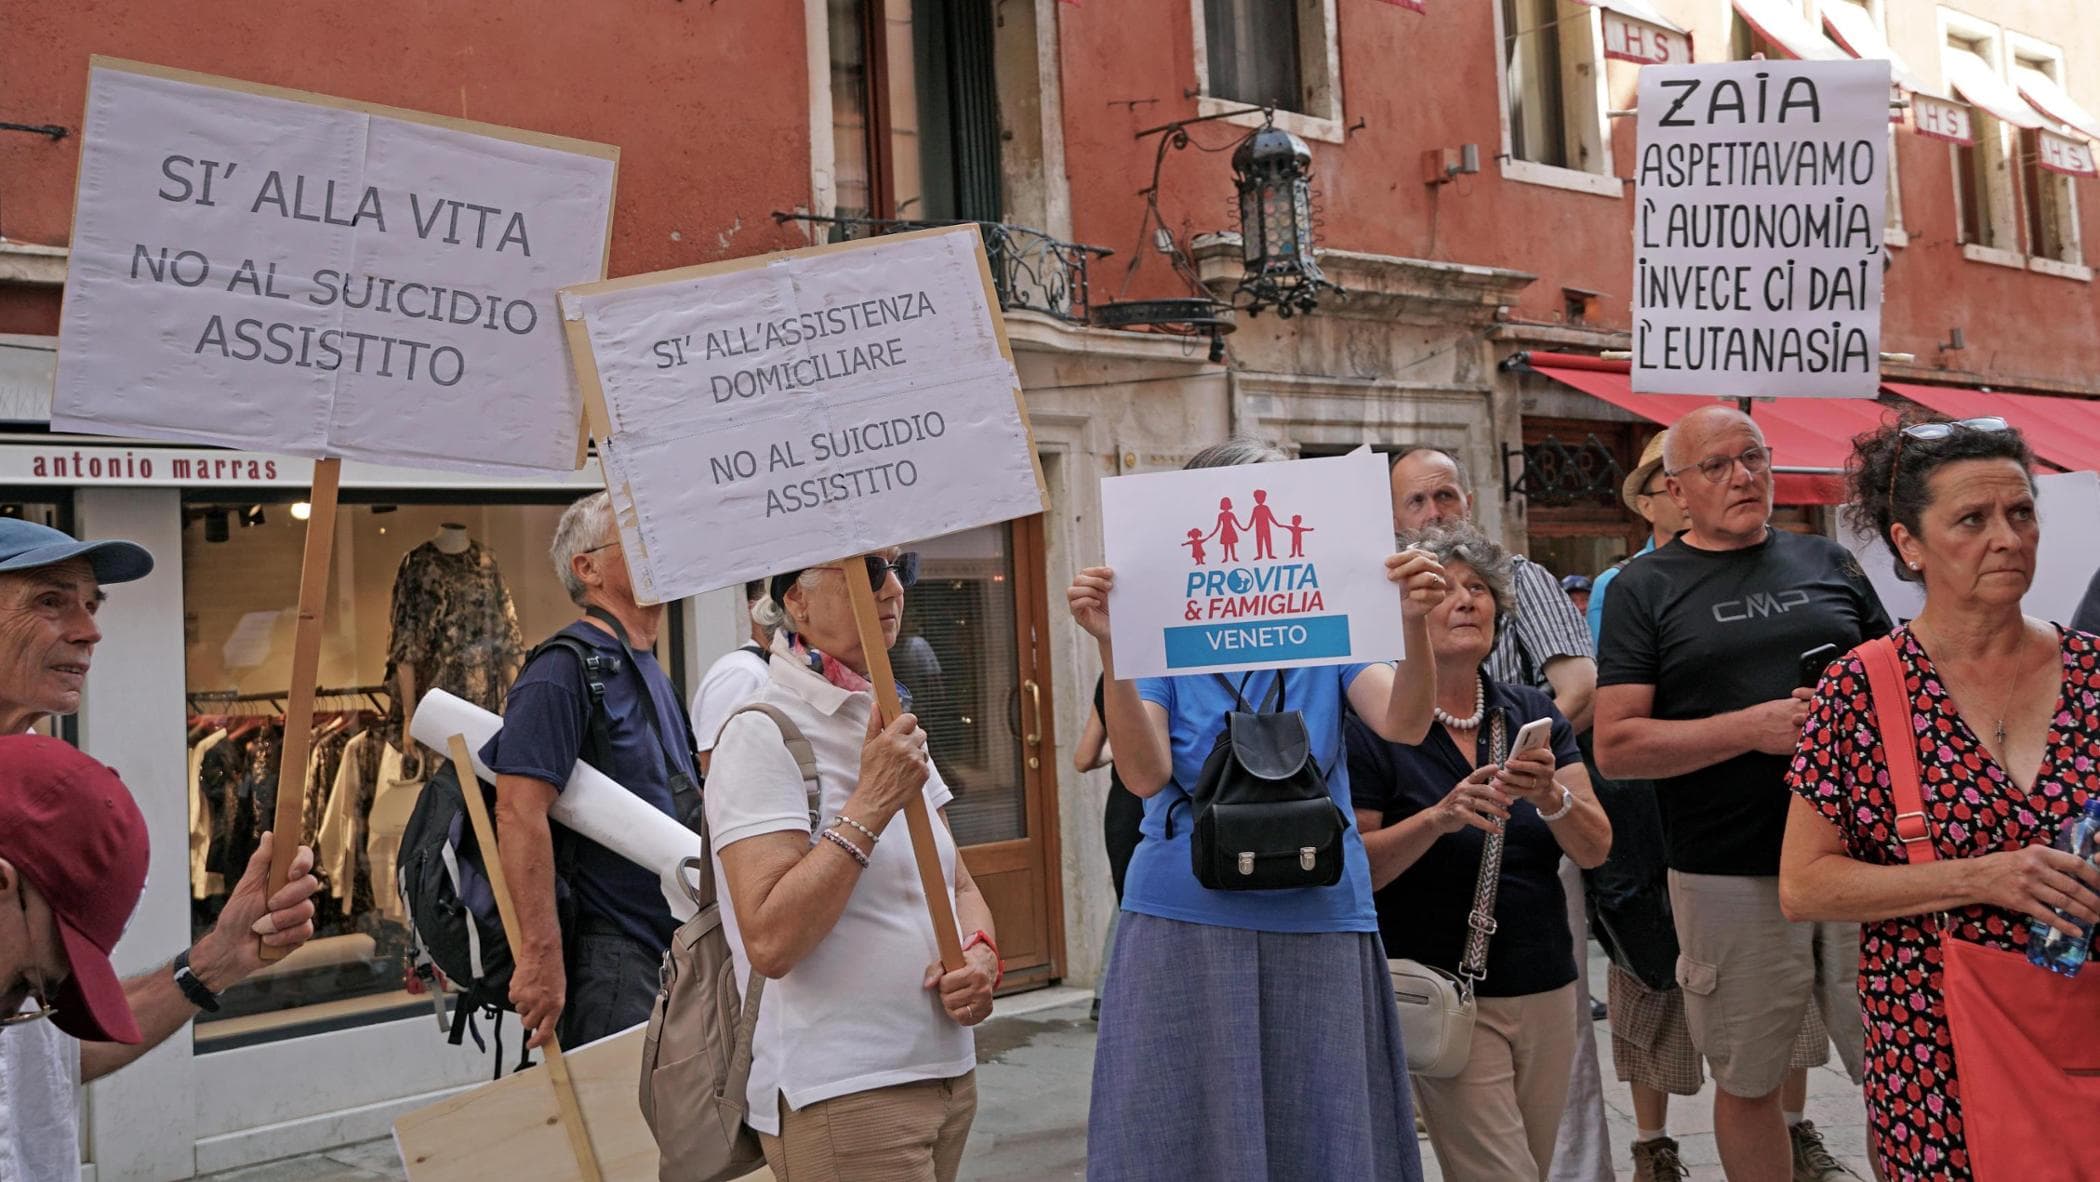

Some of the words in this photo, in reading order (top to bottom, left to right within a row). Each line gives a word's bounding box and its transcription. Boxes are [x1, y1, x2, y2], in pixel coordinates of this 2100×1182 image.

[1658, 72, 1821, 127] ZAIA
[1640, 140, 1874, 188] ASPETTAVAMO
[250, 170, 387, 233] ALLA
[409, 192, 532, 257] VITA
[130, 244, 209, 288] NO
[227, 259, 291, 300] AL
[309, 269, 538, 335] SUICIDIO
[1639, 258, 1752, 312] INVECE
[1764, 260, 1795, 313] CI
[1809, 259, 1869, 312] DAI
[195, 314, 466, 387] ASSISTITO
[711, 338, 907, 404] DOMICILIARE
[33, 451, 153, 478] antonio
[172, 458, 278, 480] marras
[710, 450, 757, 485] NO
[769, 440, 805, 474] AL
[811, 410, 945, 462] SUICIDIO
[765, 459, 918, 518] ASSISTITO
[1184, 600, 1202, 621] &
[1208, 591, 1325, 620] FAMIGLIA
[1712, 590, 1810, 622] CMP
[1206, 625, 1308, 650] VENETO
